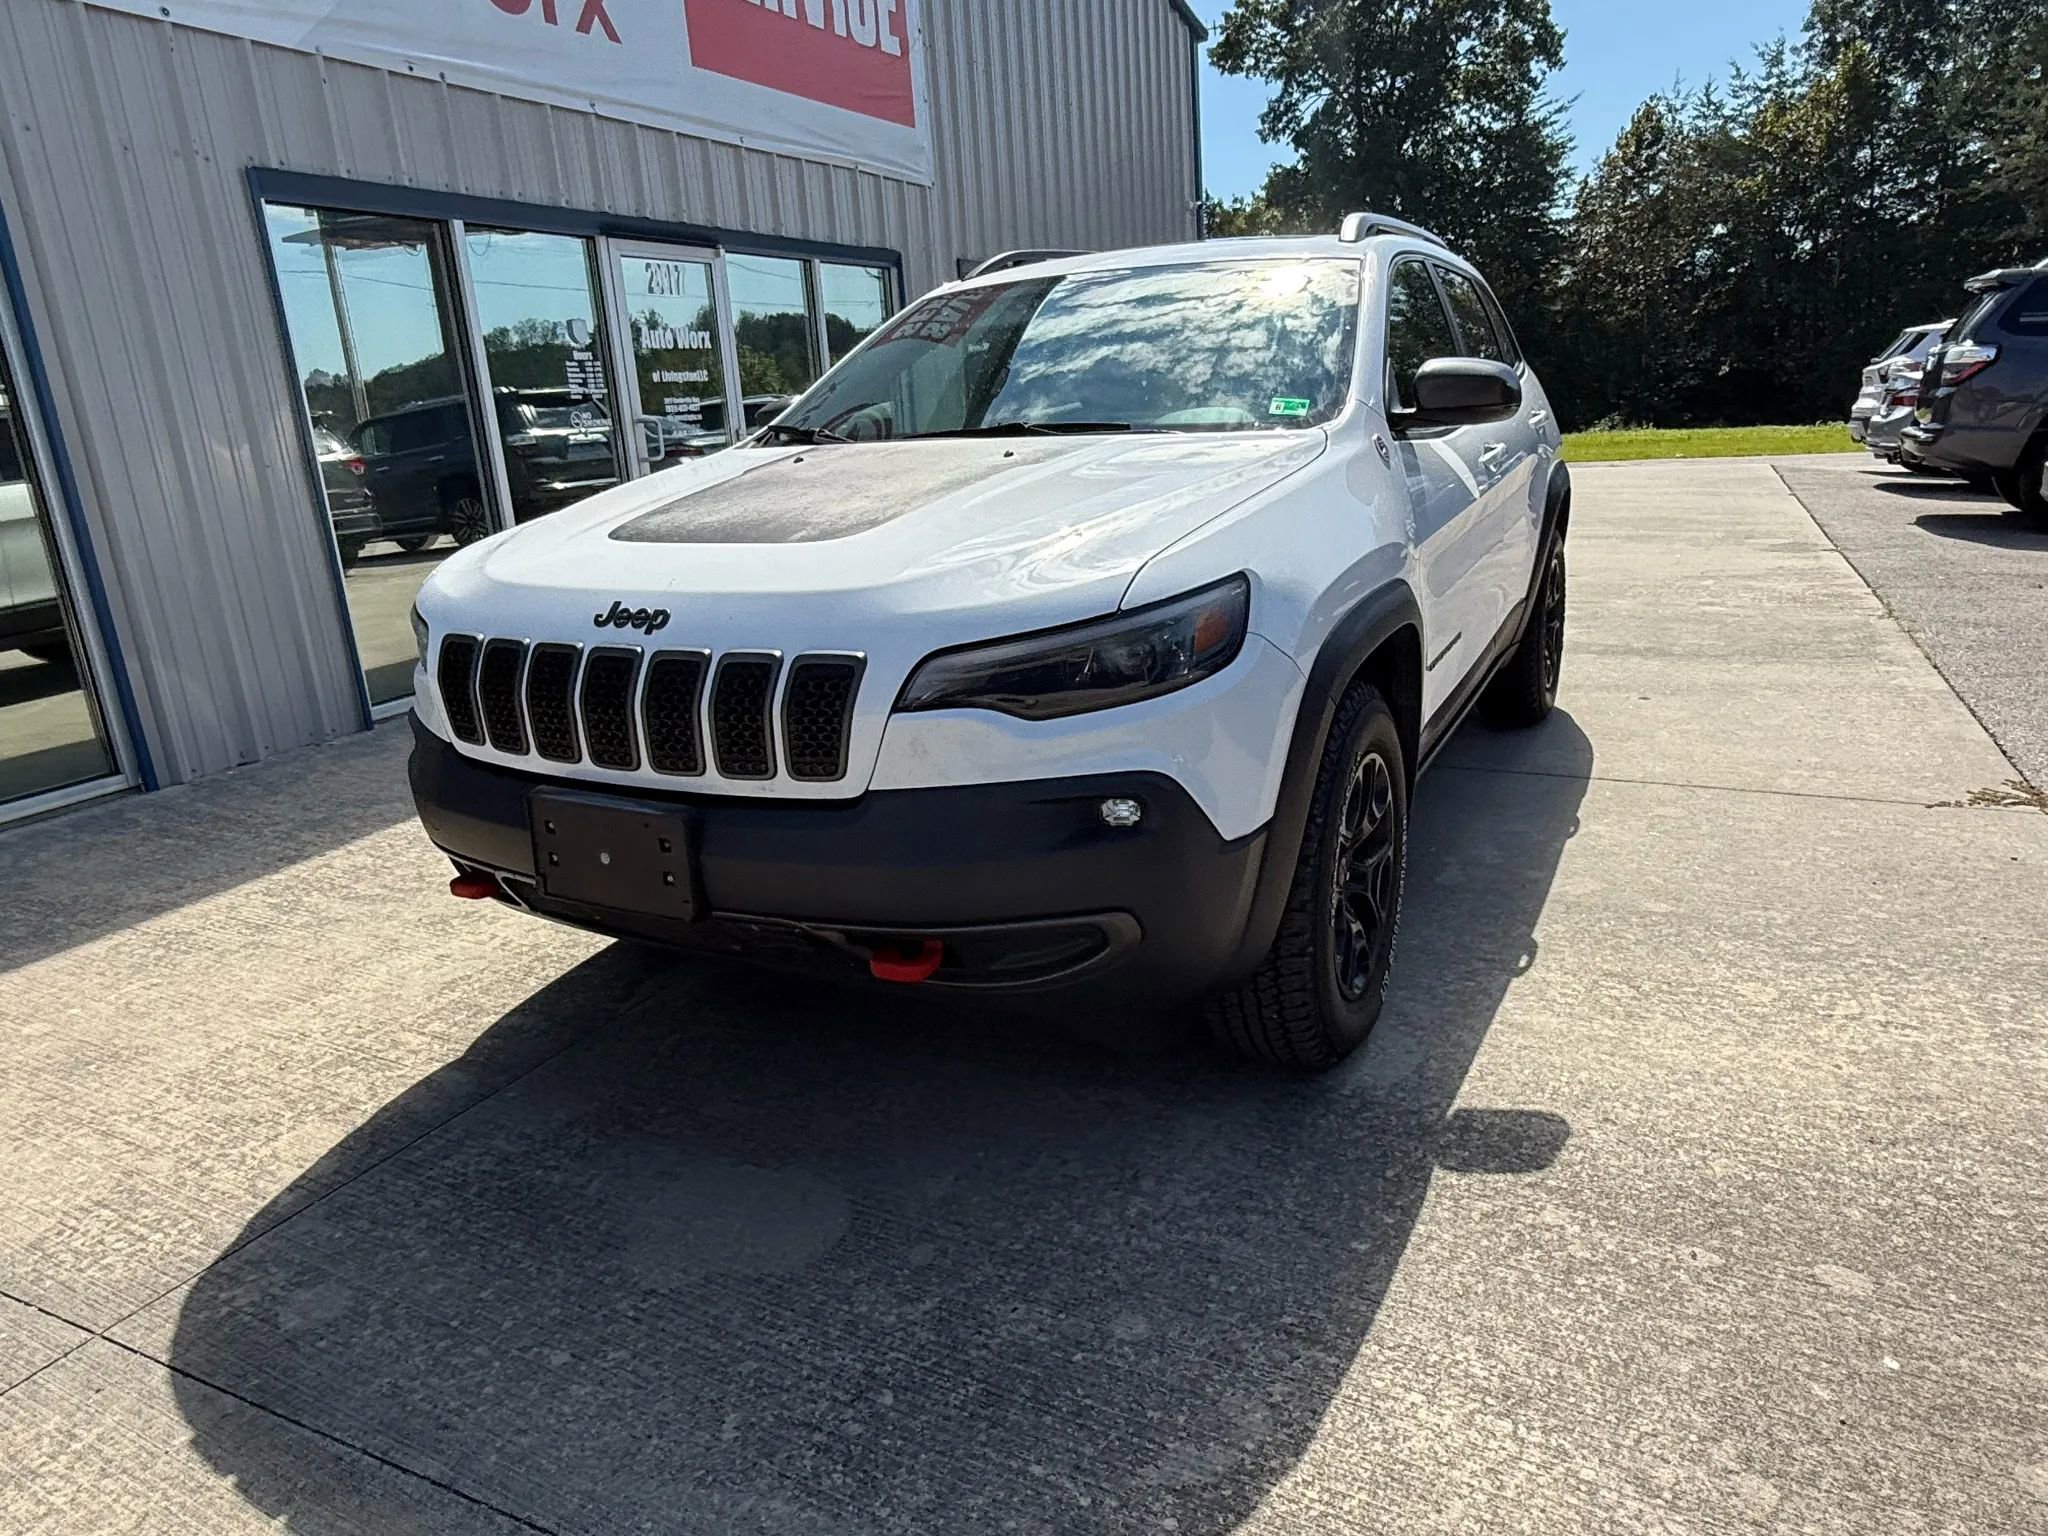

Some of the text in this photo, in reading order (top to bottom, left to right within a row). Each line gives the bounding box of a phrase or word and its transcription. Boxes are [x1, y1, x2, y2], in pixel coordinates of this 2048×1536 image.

[641, 327, 712, 349] Auto Worx
[652, 370, 661, 383] of
[594, 600, 671, 635] Jeep
